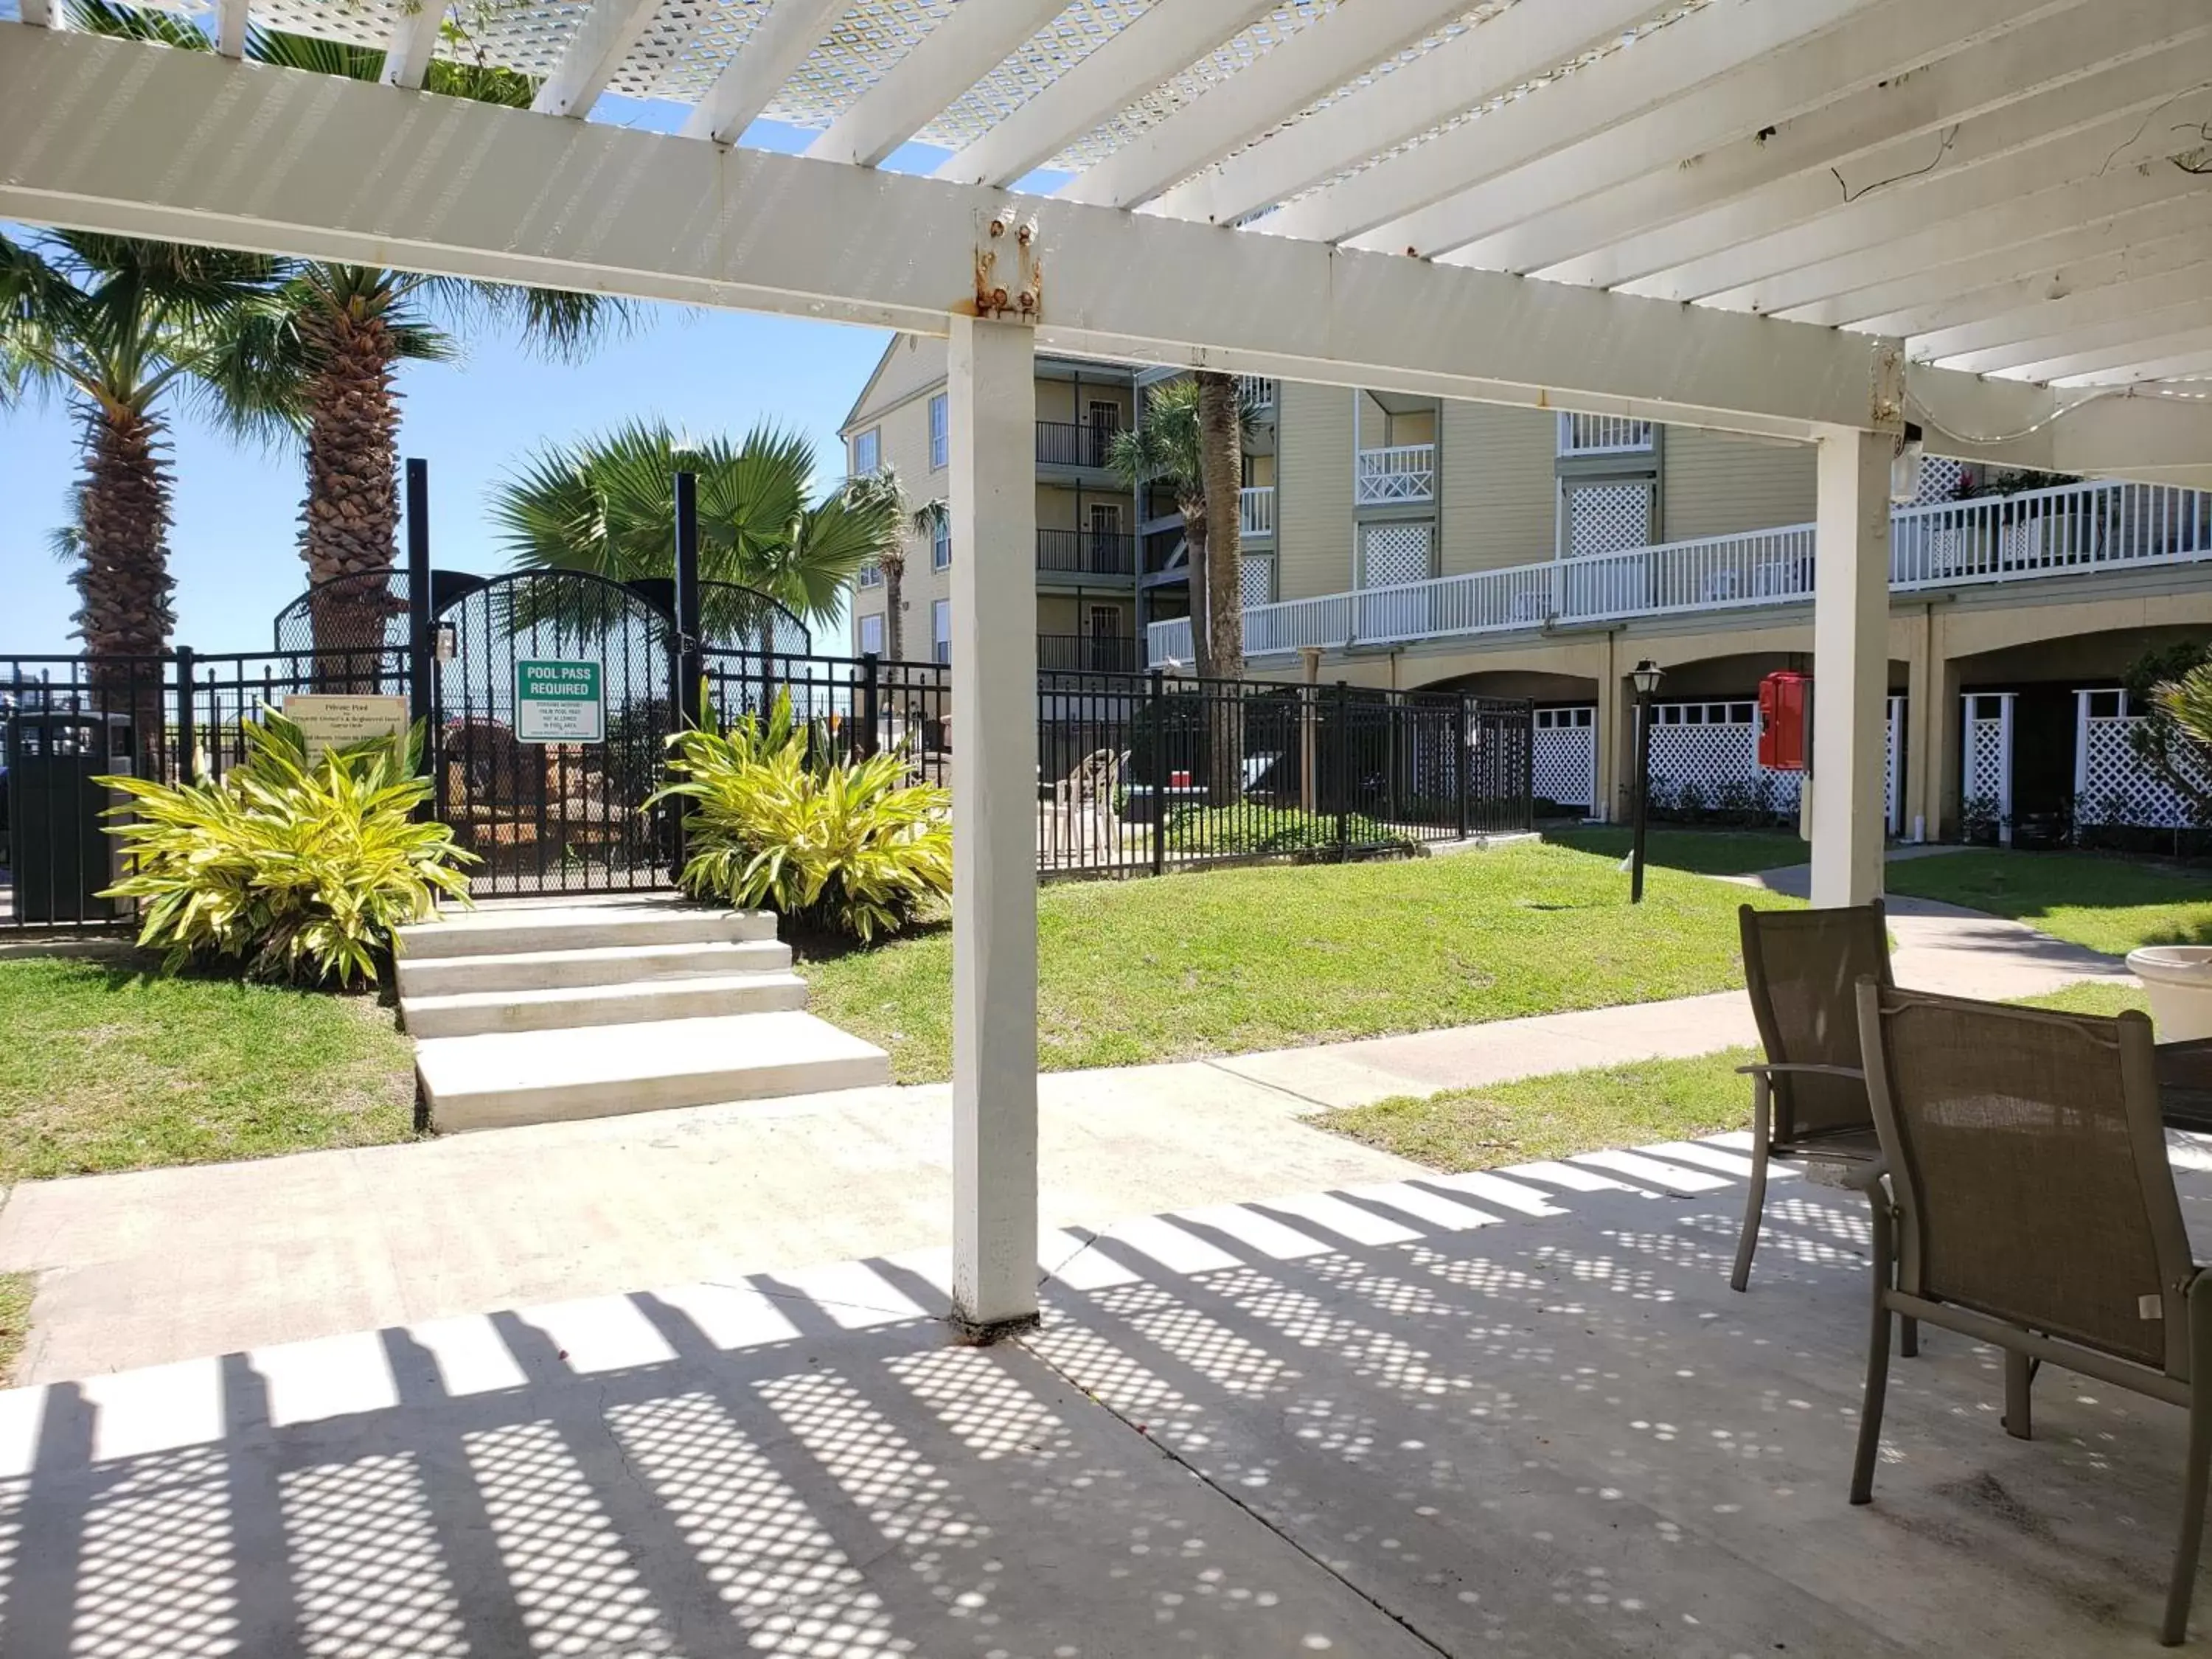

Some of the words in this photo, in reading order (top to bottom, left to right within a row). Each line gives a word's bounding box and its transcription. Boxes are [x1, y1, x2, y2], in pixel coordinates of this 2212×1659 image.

[527, 667, 558, 679] POOL
[560, 667, 591, 680] PASS
[530, 682, 588, 695] REQUIRED
